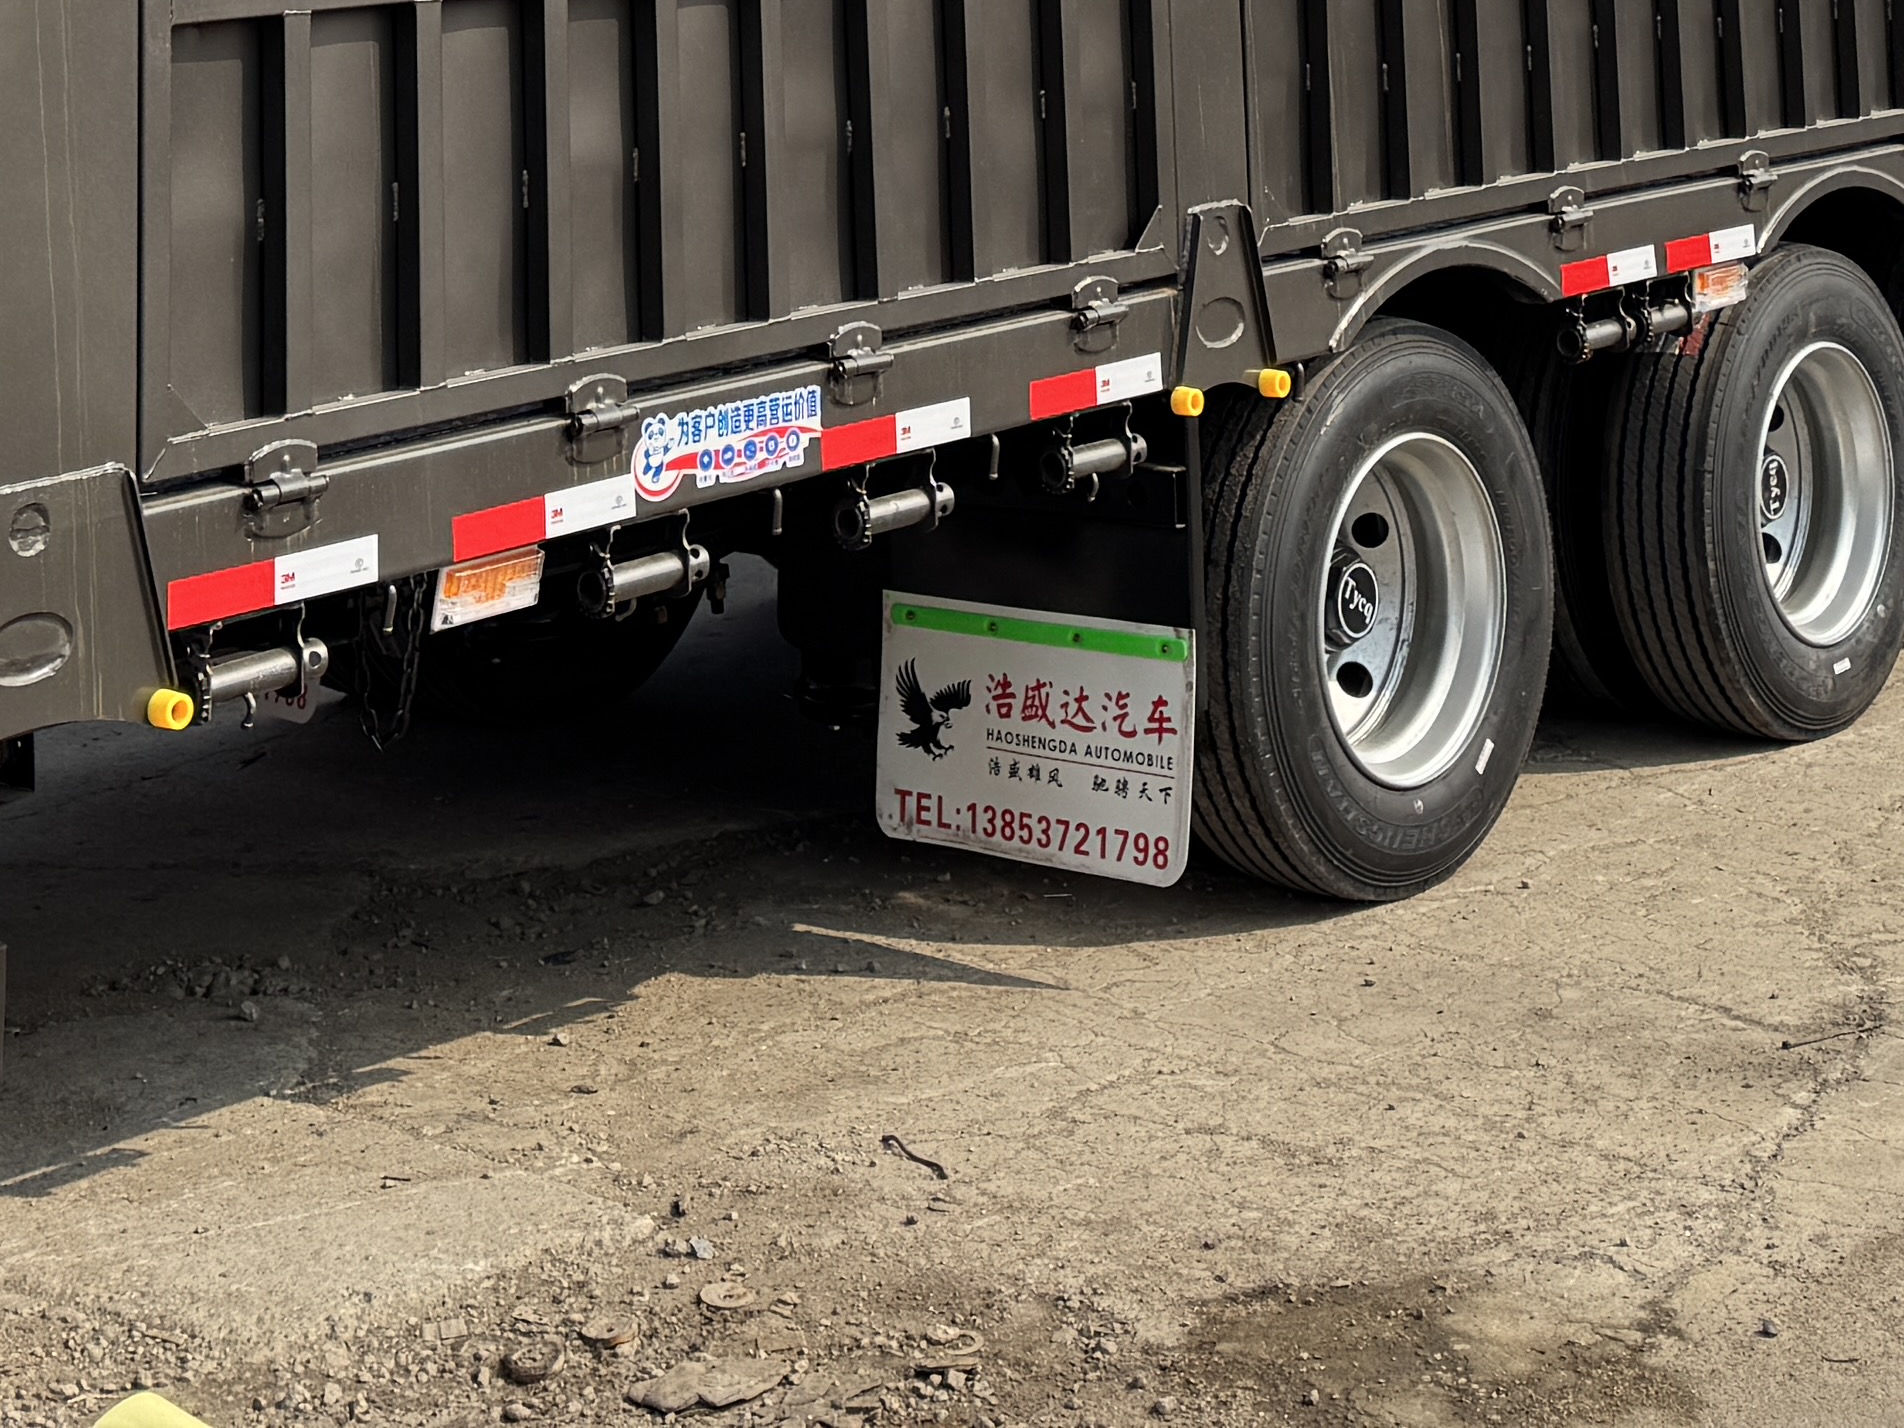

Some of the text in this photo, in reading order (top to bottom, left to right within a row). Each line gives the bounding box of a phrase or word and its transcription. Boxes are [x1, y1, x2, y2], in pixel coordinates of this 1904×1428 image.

[678, 390, 819, 448] 为客户创造更高营运价值
[985, 672, 1178, 745] 浩盛达汽车
[986, 728, 1174, 771] HAOSHENGDA AUTOMOBILE
[894, 788, 1171, 871] TEL:13853721798
